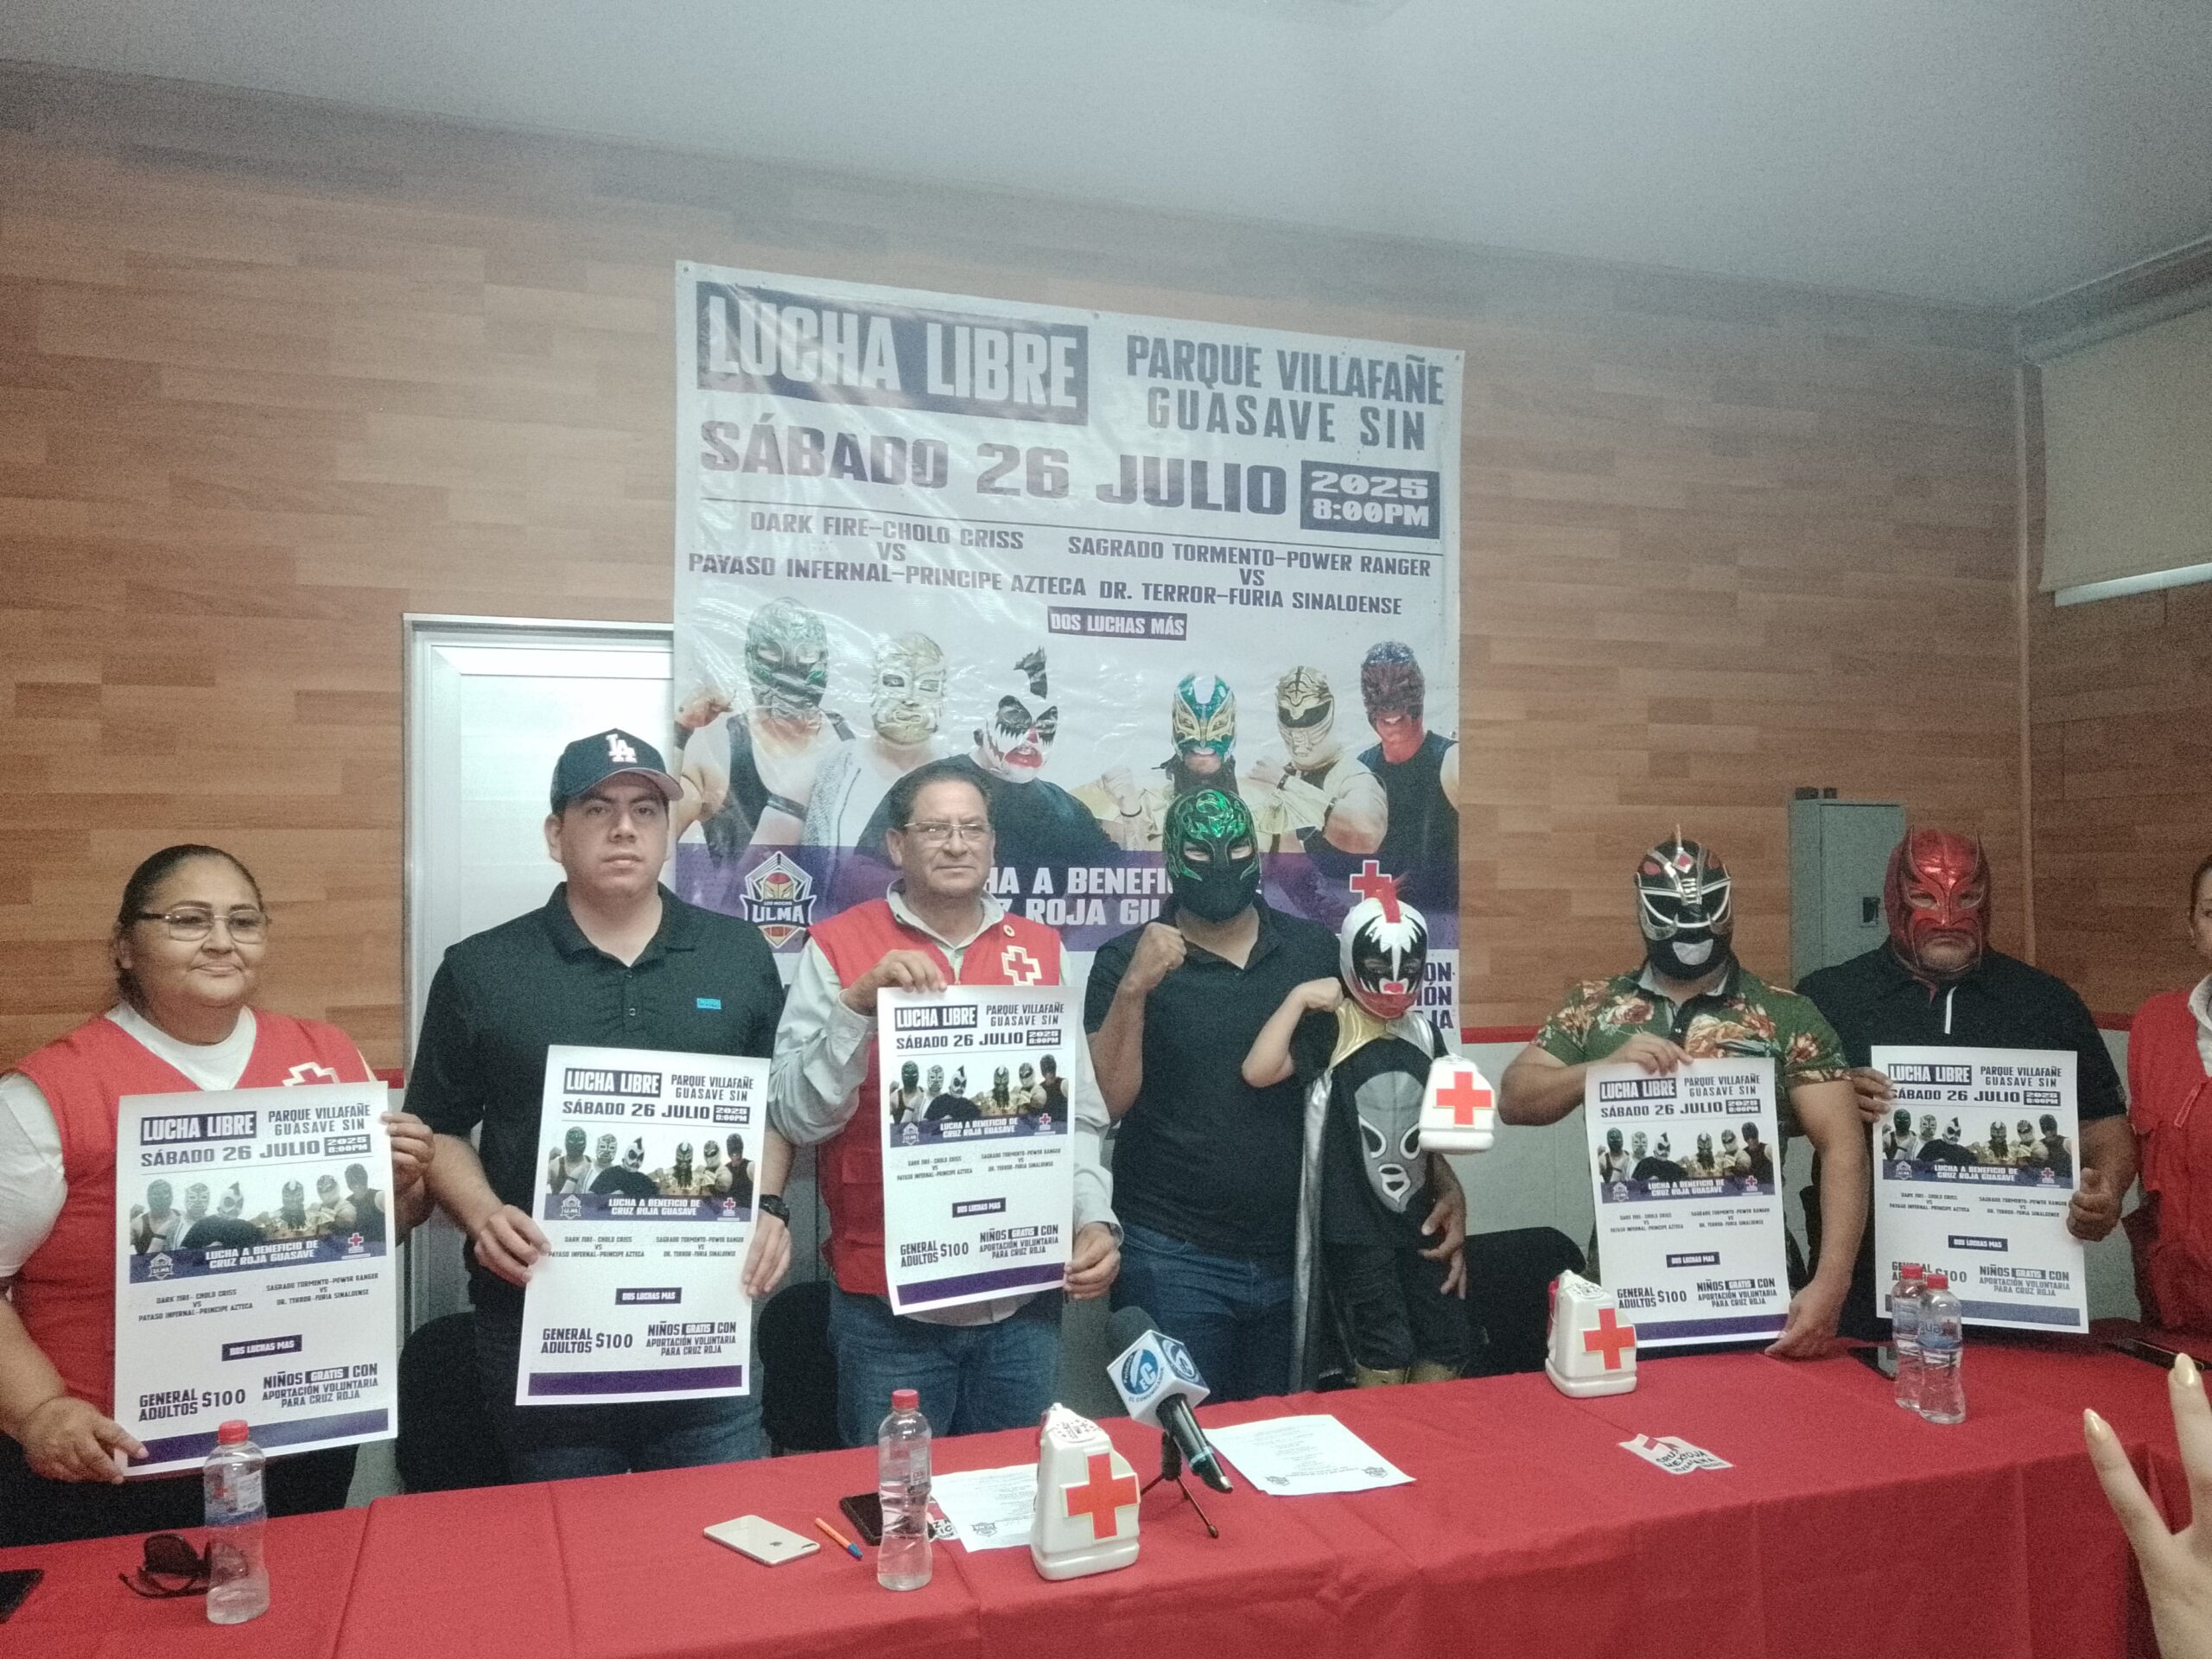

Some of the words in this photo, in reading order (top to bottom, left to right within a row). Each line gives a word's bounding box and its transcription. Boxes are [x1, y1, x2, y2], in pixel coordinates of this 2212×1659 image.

[709, 296, 901, 391] LUCHA
[926, 322, 1077, 408] LIBRE
[1127, 334, 1262, 388] PARQUE
[1277, 349, 1444, 406] VILLAFAÑE
[1147, 385, 1335, 443] GUASAVE
[1360, 406, 1425, 450] SIN
[701, 413, 949, 488] SÁBADO
[976, 442, 1070, 499] 26
[1096, 454, 1287, 516] JULIO
[1311, 471, 1428, 499] 2025
[1313, 499, 1429, 527] 8:00PM
[751, 511, 812, 534] DARK
[960, 529, 1024, 550] CRISS
[877, 542, 906, 561] VS
[1068, 536, 1164, 560] SAGRADO
[1361, 556, 1431, 576] RANGER
[689, 553, 776, 576] PAYASO
[1011, 575, 1086, 596] AZTECA
[1239, 568, 1265, 587] VS
[1099, 580, 1133, 600] DR.
[1292, 592, 1402, 615] SINALOENSE
[1052, 613, 1081, 632] DOS
[1087, 614, 1145, 635] LUCHAS
[1151, 615, 1185, 636] MÁS
[606, 734, 637, 763] LA
[1033, 868, 1053, 893] A
[752, 904, 804, 923] ULMA
[1027, 899, 1106, 925] ROJA
[896, 1009, 938, 1027] LUCHA
[943, 1007, 976, 1026] LIBRE
[986, 1005, 1018, 1015] PARQUE
[1022, 1002, 1065, 1014] VILLAFAÑE
[991, 1015, 1036, 1027] GUASAVE
[1041, 1015, 1058, 1025] SIN
[896, 1035, 948, 1050] SÁBADO
[953, 1034, 974, 1046] 26
[979, 1033, 1023, 1046] JULIO
[1891, 1067, 1931, 1082] LUCHA
[1936, 1067, 1971, 1084] LIBRE
[1980, 1066, 2013, 1077] PARQUE
[2017, 1065, 2063, 1077] VILLAFAÑE
[566, 1071, 613, 1091] LUCHA
[620, 1074, 660, 1094] LIBRE
[671, 1074, 705, 1089] PARQUE
[709, 1076, 753, 1090] VILLAFAÑE
[1685, 1077, 1715, 1087] PARQUE
[1719, 1074, 1760, 1084] VILLAFAÑE
[1986, 1077, 2032, 1086] GUASAVE
[2038, 1077, 2056, 1087] SIN
[676, 1089, 724, 1101] GUASAVE
[729, 1090, 747, 1102] SIN
[1601, 1081, 1638, 1099] LUCHA
[1643, 1080, 1675, 1096] LIBRE
[1689, 1086, 1733, 1097] GUASAVE
[1739, 1085, 1756, 1095] SIN
[1947, 1090, 1967, 1101] 26
[1974, 1091, 2020, 1103] JULIO
[269, 1109, 311, 1126] PARQUE
[315, 1103, 370, 1118] VILLAFAÑE
[563, 1099, 626, 1116] SÁBADO
[631, 1103, 655, 1117] 26
[661, 1104, 710, 1119] JULIO
[1601, 1104, 1649, 1118] SÁBADO
[1655, 1104, 1675, 1116] 26
[1680, 1102, 1723, 1113] JULIO
[143, 1117, 201, 1141] LUCHA
[207, 1114, 254, 1136] LIBRE
[274, 1119, 335, 1135] GUASAVE
[342, 1118, 365, 1130] SIN
[141, 1147, 215, 1166] SÁBADO
[223, 1146, 251, 1161] 26
[259, 1140, 320, 1158] JULIO
[980, 1228, 1007, 1243] NIÑOS
[1011, 1229, 1035, 1237] GRATIS
[1041, 1225, 1058, 1236] CON
[206, 1250, 238, 1261] LUCHA
[253, 1242, 301, 1255] BENEFICIO
[306, 1240, 318, 1249] DE
[900, 1241, 938, 1255] GENERAL
[940, 1242, 969, 1257] $100
[979, 1241, 1018, 1252] APORTACIÓN
[1020, 1236, 1058, 1247] VOLUNTARIA
[992, 1249, 1009, 1259] PARA
[1011, 1248, 1027, 1256] CRUZ
[1029, 1246, 1046, 1255] ROJA
[209, 1258, 236, 1268] CRUZ
[240, 1255, 267, 1265] ROJA
[270, 1249, 315, 1262] GUASAVE
[901, 1253, 938, 1268] ADULTOS
[1980, 1264, 2010, 1277] NIÑOS
[2049, 1270, 2069, 1281] CON
[1697, 1279, 1724, 1292] NIÑOS
[1758, 1278, 1776, 1288] CON
[1979, 1276, 2024, 1287] APORTACIÓN
[2025, 1281, 2070, 1290] VOLUNTARIA
[1994, 1285, 2013, 1294] PARA
[2016, 1287, 2035, 1295] CRUZ
[2037, 1287, 2056, 1296] ROJA
[1618, 1287, 1656, 1299] GENERAL
[1658, 1290, 1687, 1302] $100
[1698, 1289, 1736, 1300] APORTACIÓN
[1738, 1289, 1777, 1298] VOLUNTARIA
[1731, 1298, 1748, 1306] CRUZ
[1750, 1297, 1766, 1306] ROJA
[1618, 1298, 1656, 1309] ADULTOS
[543, 1328, 593, 1341] GENERAL
[648, 1321, 680, 1337] NIÑOS
[685, 1324, 712, 1333] GRATIS
[717, 1322, 736, 1333] CON
[541, 1340, 592, 1354] ADULTOS
[595, 1333, 632, 1349] $100
[645, 1335, 692, 1347] APORTACIÓN
[695, 1335, 736, 1344] VOLUNTARIA
[661, 1347, 681, 1357] PARA
[703, 1345, 721, 1354] ROJA
[264, 1371, 302, 1389] NIÑOS
[310, 1370, 344, 1381] GRATIS
[353, 1363, 378, 1377] CON
[201, 1389, 246, 1407] $100
[262, 1383, 319, 1401] APORTACIÓN
[323, 1378, 378, 1393] VOLUNTARIA
[140, 1389, 198, 1408] GENERAL
[281, 1396, 306, 1408] PARA
[308, 1394, 333, 1405] CRUZ
[337, 1391, 360, 1402] ROJA
[138, 1402, 198, 1421] ADULTOS
